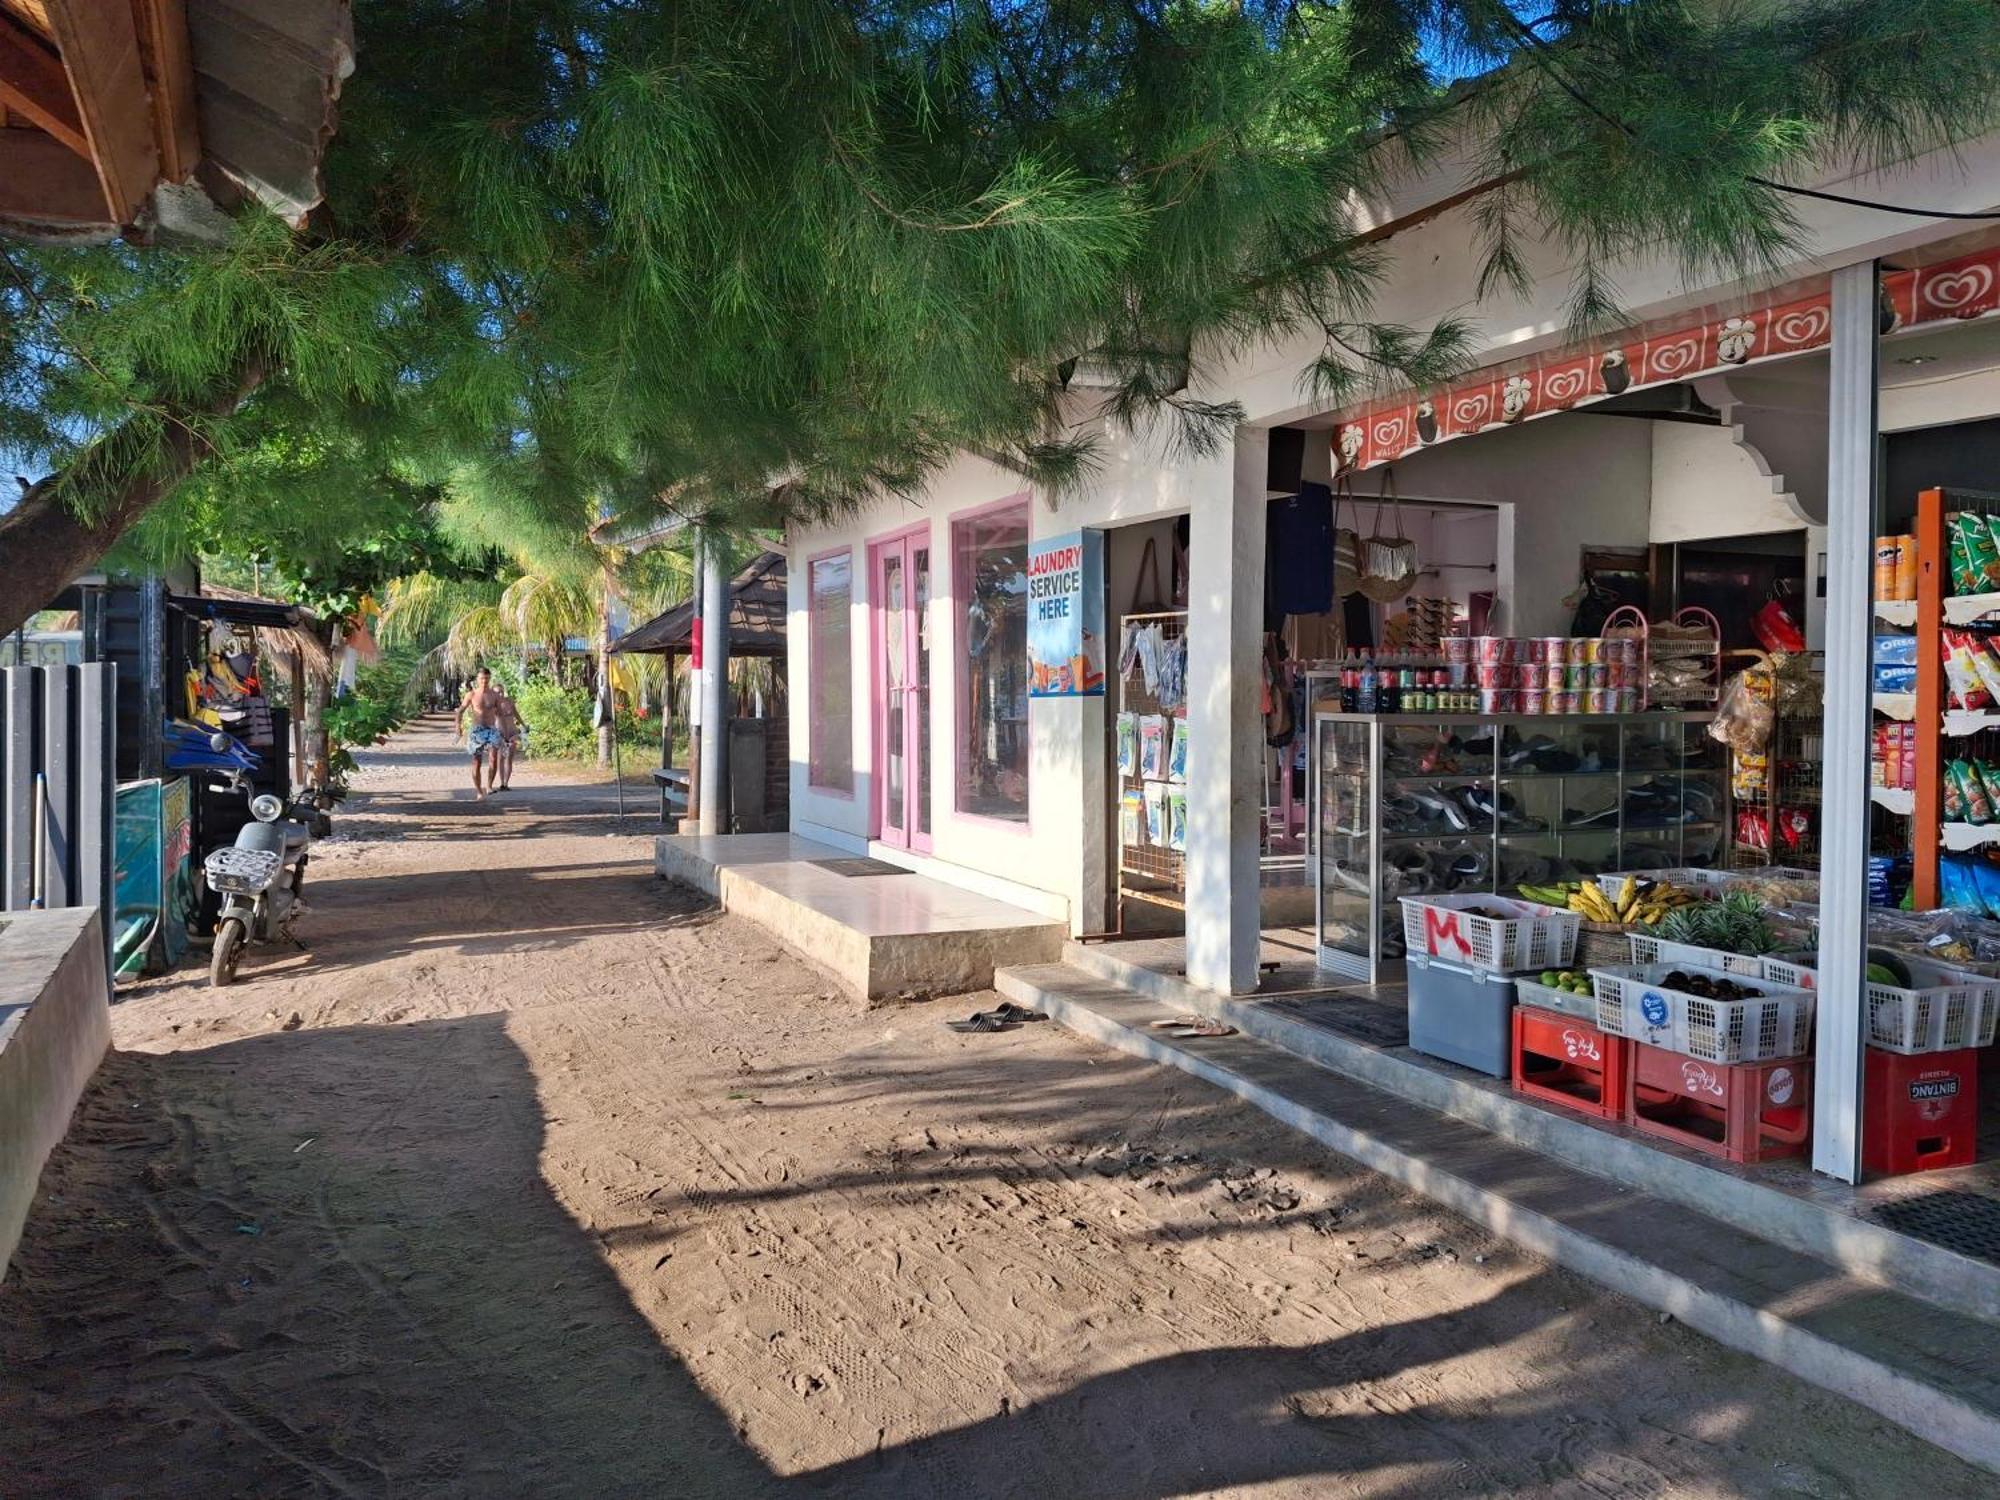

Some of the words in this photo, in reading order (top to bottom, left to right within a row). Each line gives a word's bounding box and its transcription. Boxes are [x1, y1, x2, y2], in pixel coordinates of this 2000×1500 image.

[1027, 546, 1082, 577] LAUNDRY
[1030, 570, 1080, 599] SERVICE
[1038, 597, 1069, 621] HERE
[1424, 906, 1472, 956] M
[1912, 1082, 1957, 1097] BINTANG
